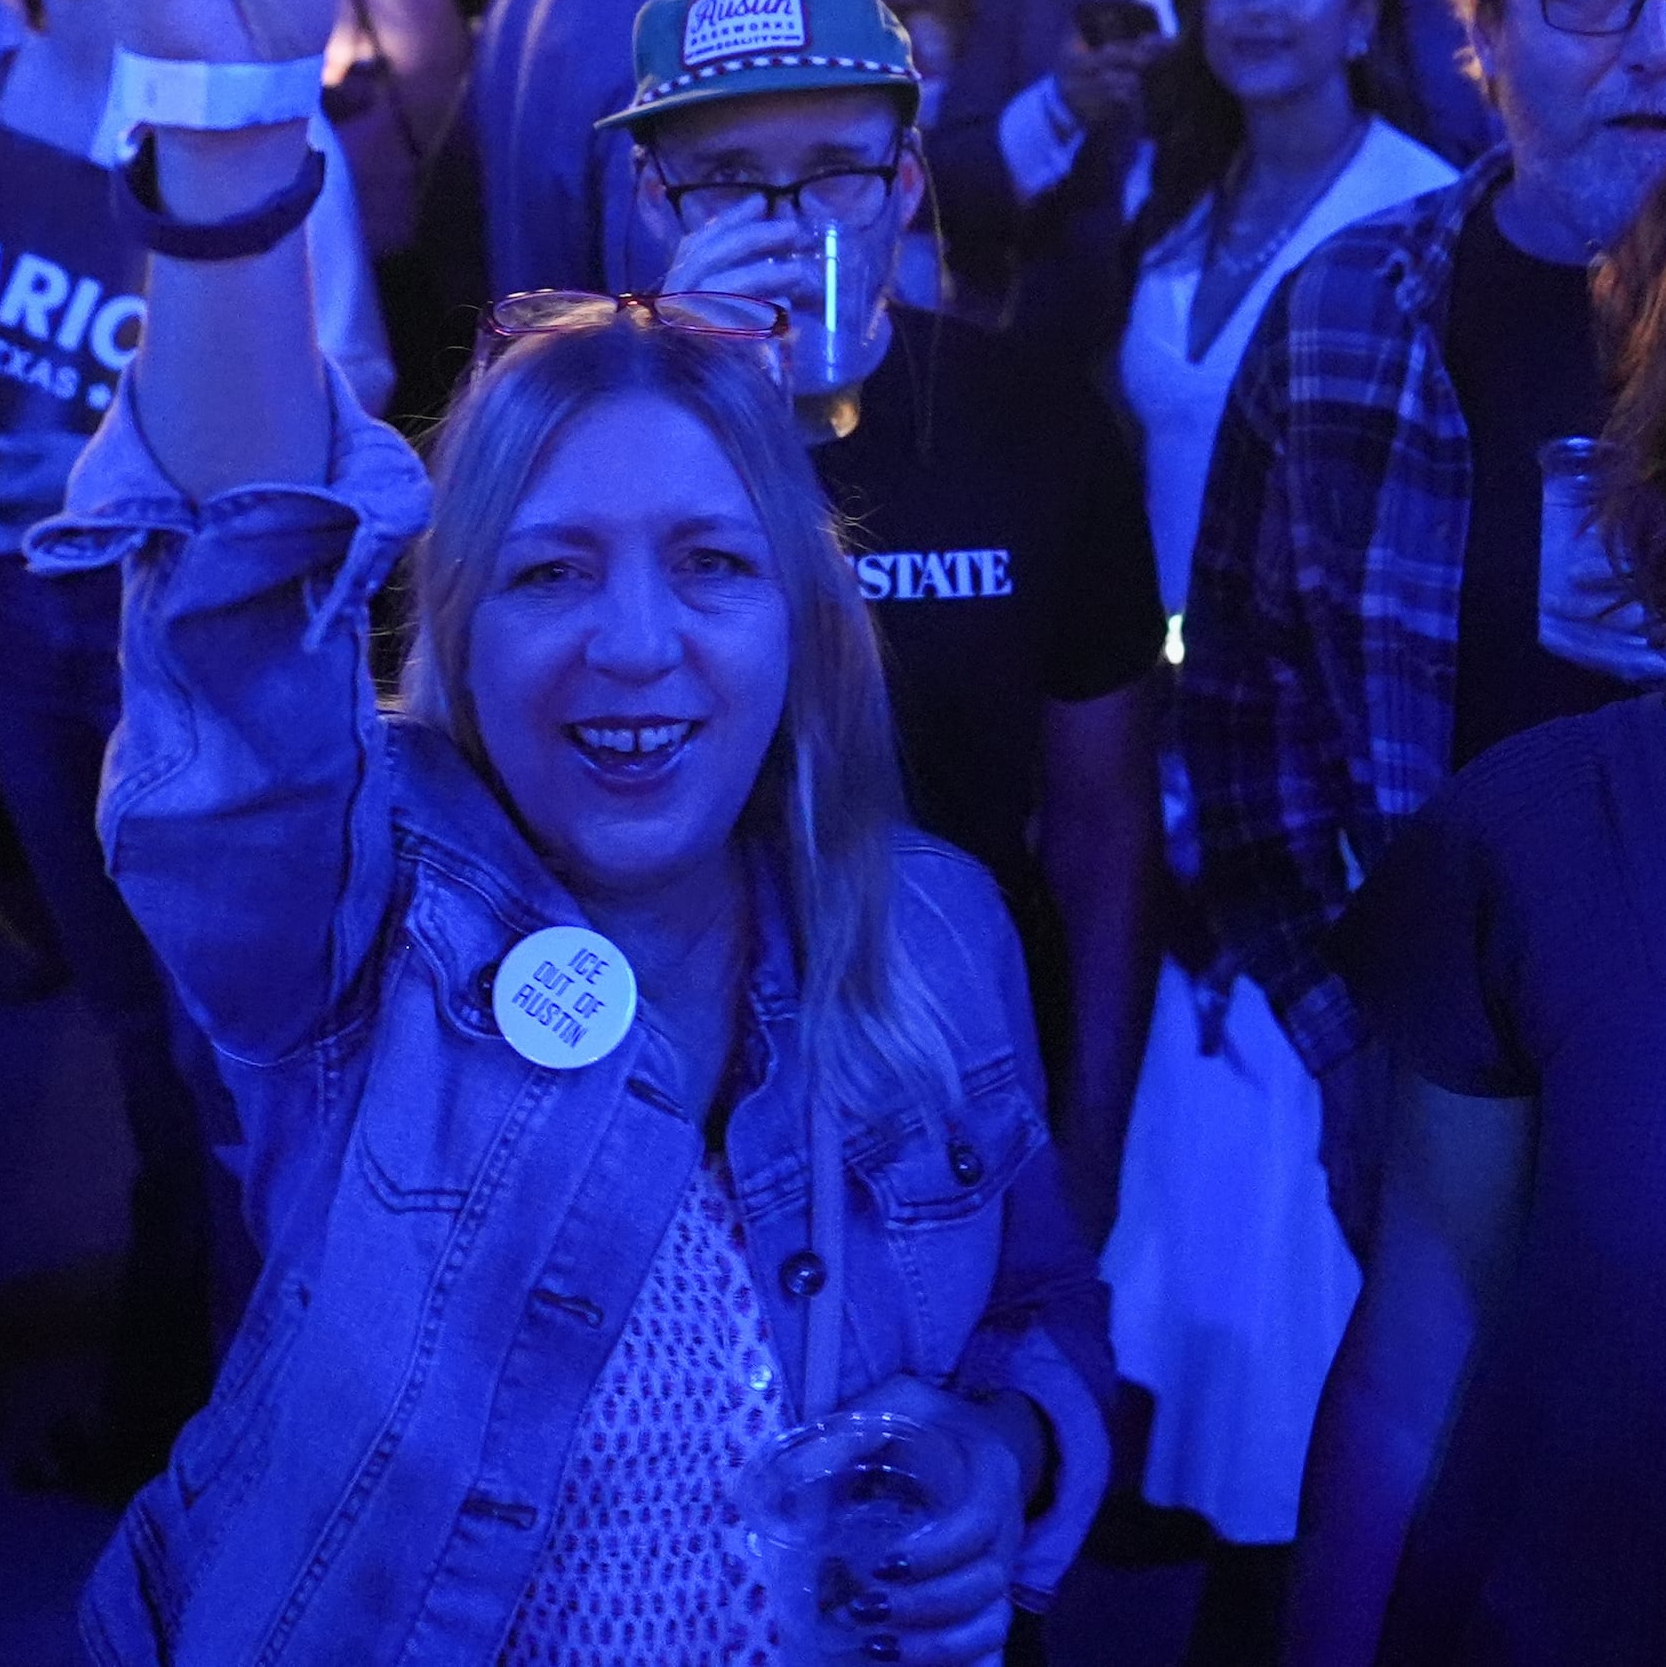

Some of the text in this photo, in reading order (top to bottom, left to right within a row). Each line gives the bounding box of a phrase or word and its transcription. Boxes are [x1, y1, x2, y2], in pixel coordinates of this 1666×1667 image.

[534, 960, 606, 1020] OUT OF
[568, 947, 610, 985] ICE
[511, 983, 589, 1049] AUSTIN
